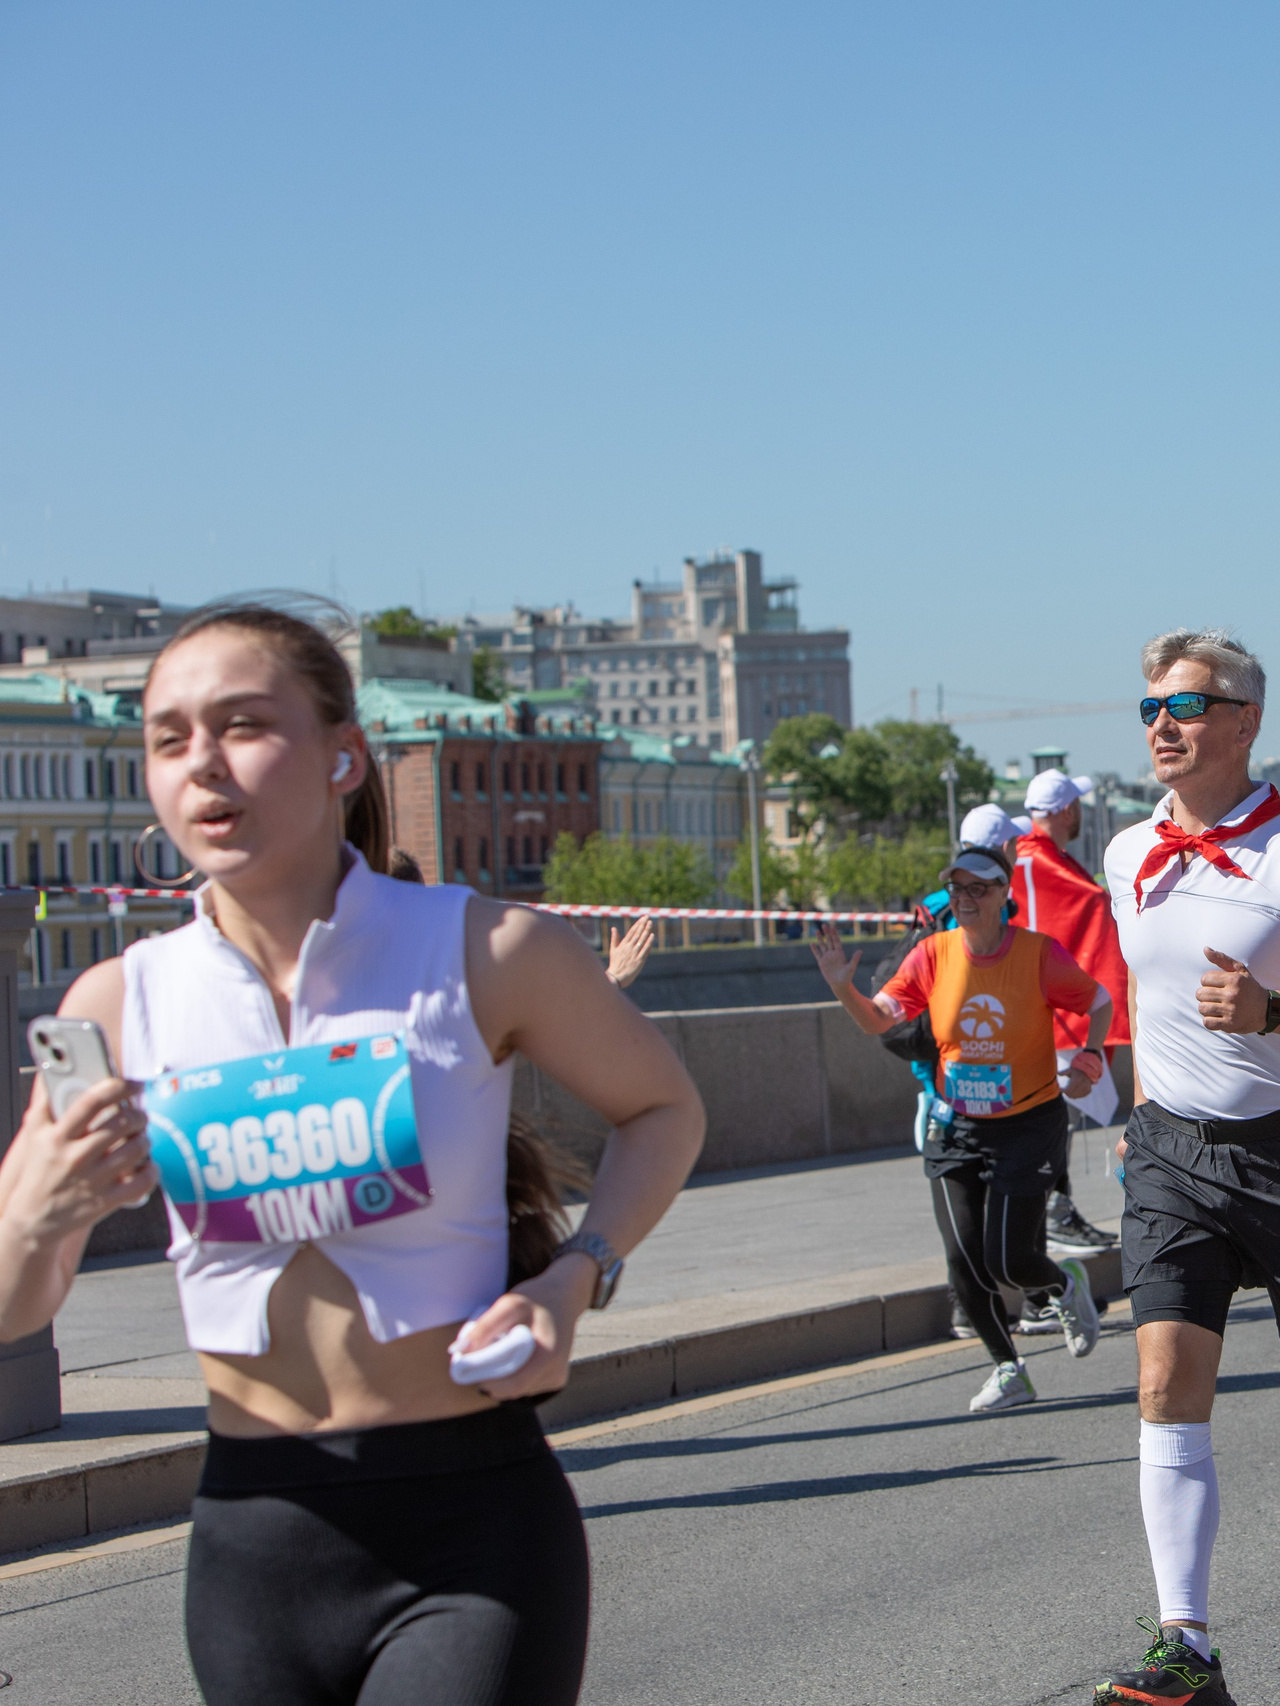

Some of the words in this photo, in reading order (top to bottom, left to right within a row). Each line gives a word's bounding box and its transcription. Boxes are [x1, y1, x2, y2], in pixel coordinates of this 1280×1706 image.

[960, 1040, 1005, 1052] SOCHI
[197, 1097, 373, 1192] 36360
[363, 1181, 386, 1207] D
